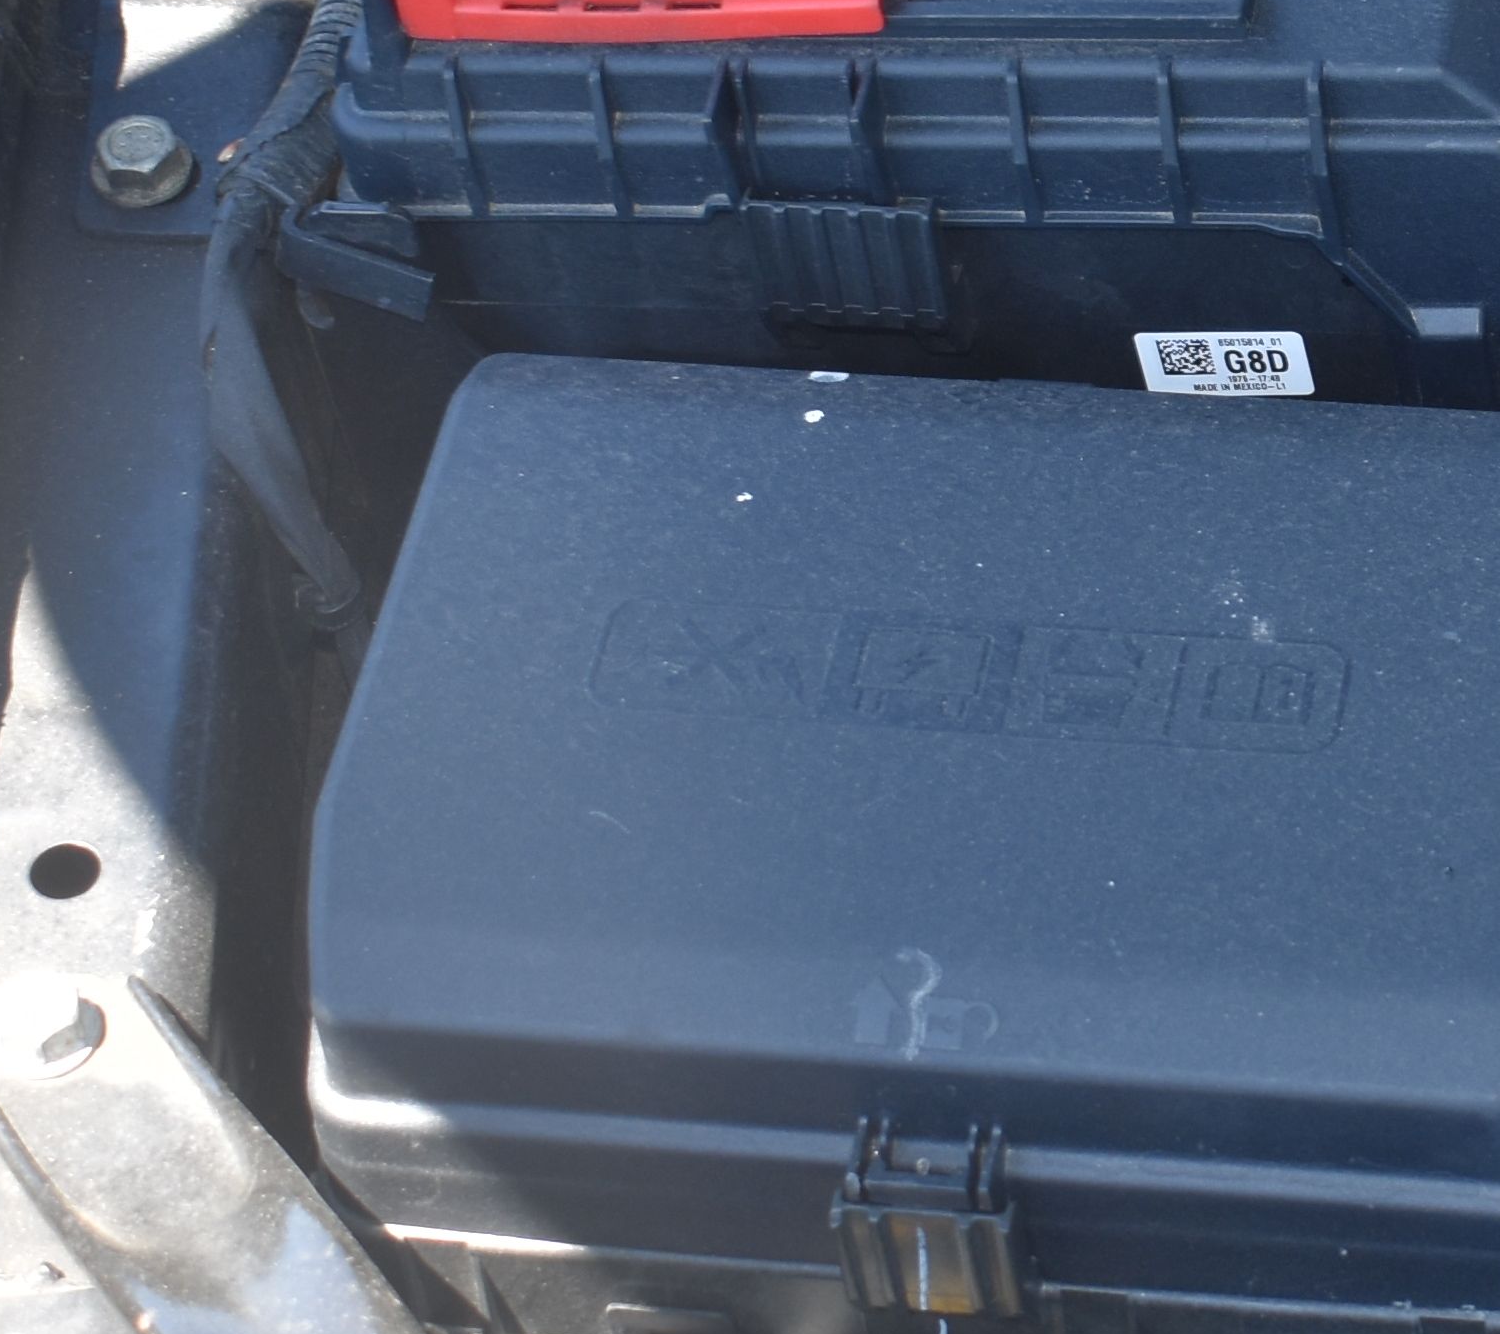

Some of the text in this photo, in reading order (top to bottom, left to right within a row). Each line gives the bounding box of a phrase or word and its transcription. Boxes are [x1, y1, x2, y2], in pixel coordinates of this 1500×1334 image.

[1223, 349, 1289, 374] G8D
[1193, 382, 1219, 392] MADE
[1220, 383, 1231, 391] IN
